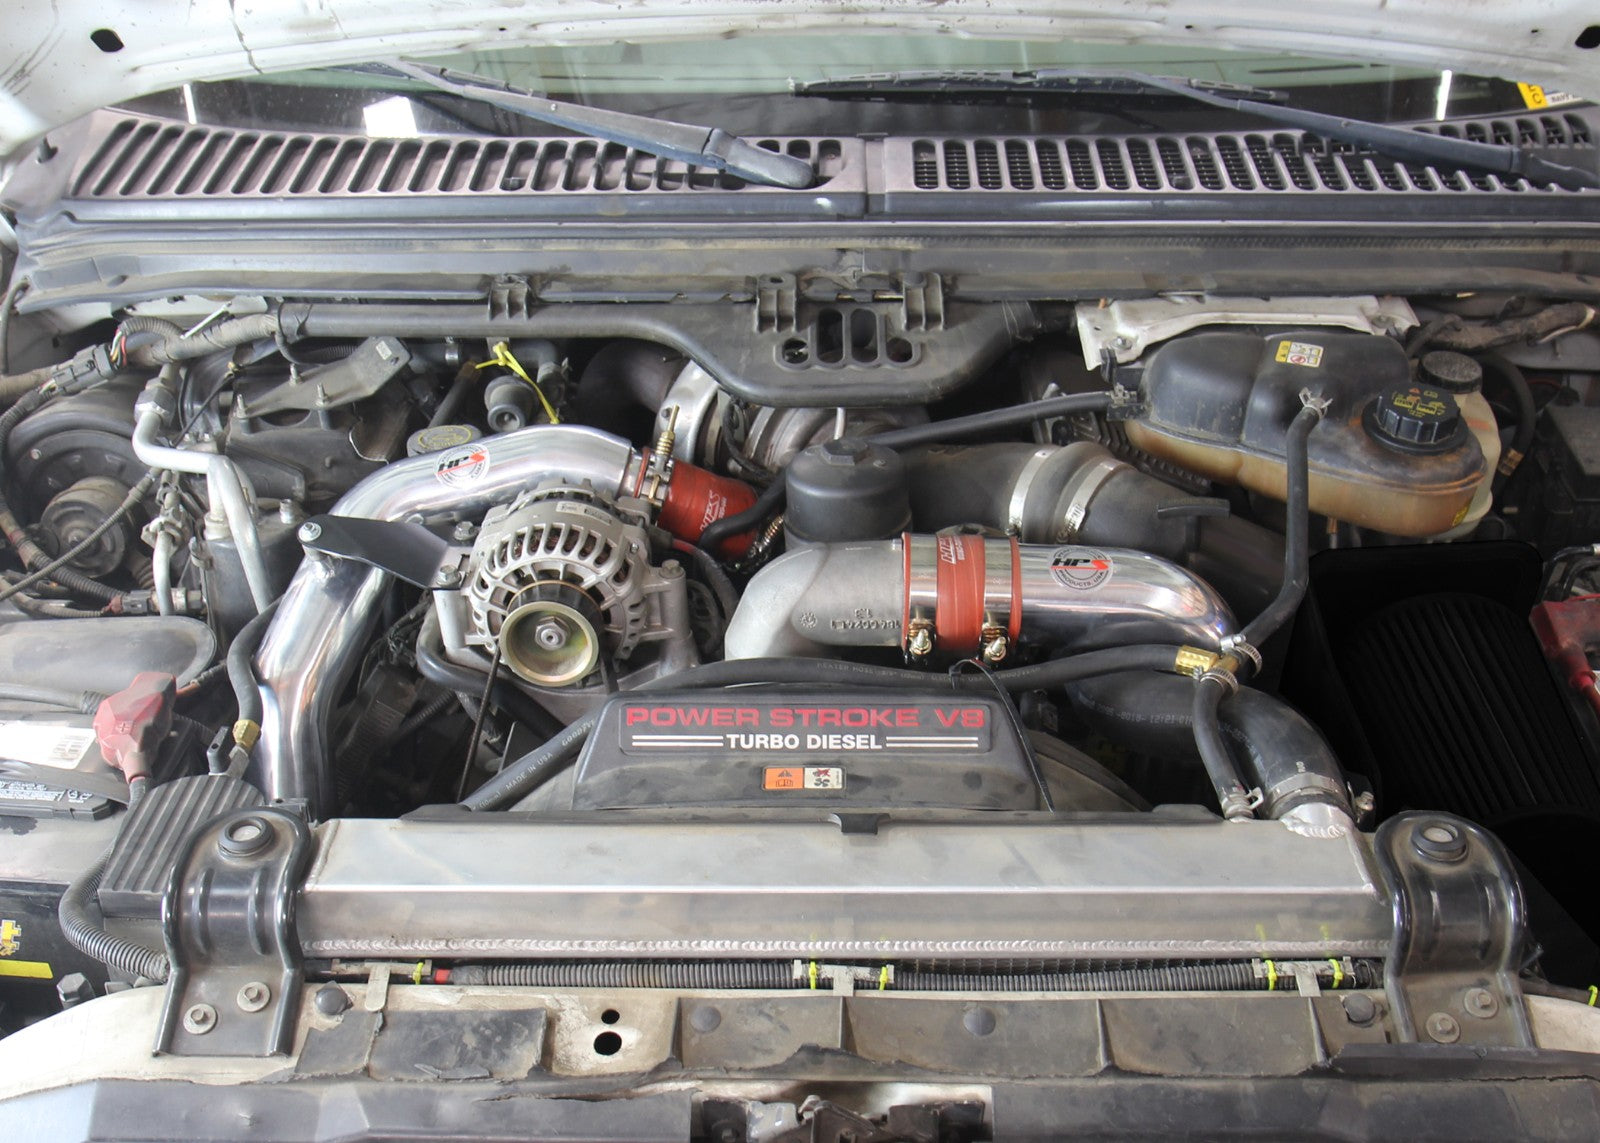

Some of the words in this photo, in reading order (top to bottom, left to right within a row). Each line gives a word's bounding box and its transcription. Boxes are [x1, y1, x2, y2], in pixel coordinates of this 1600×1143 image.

[437, 450, 487, 474] HPS
[1051, 558, 1111, 570] HPS
[1059, 569, 1092, 587] PRODUCTS
[1093, 571, 1104, 583] USA
[626, 708, 760, 728] POWER
[769, 708, 920, 728] STROKE
[935, 708, 985, 728] V8
[726, 734, 800, 750] TURBO
[806, 734, 882, 751] DIESEL
[505, 771, 528, 791] MADE
[527, 764, 537, 775] IN
[537, 751, 554, 766] USA
